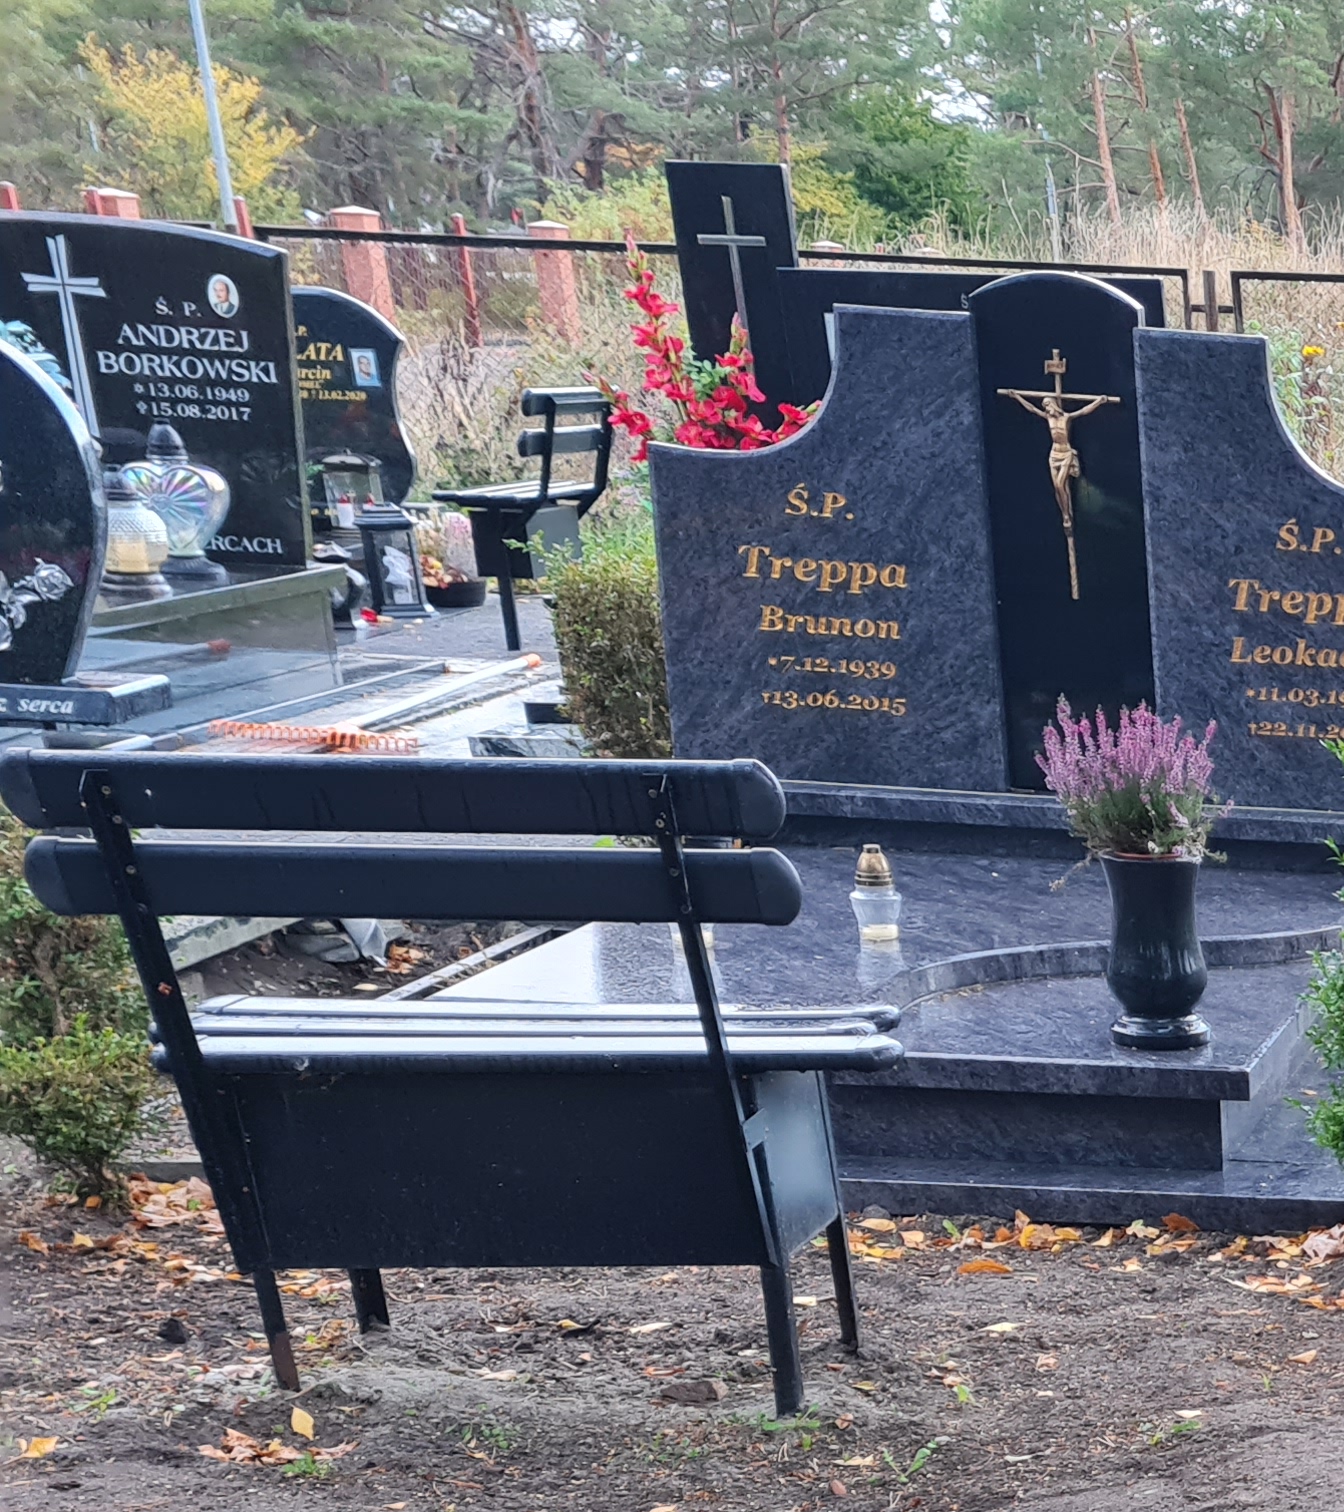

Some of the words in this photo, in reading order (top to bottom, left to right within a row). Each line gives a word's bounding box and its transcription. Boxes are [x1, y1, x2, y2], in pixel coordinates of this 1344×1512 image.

[182, 301, 202, 317] P.
[117, 322, 249, 352] ANDRZEJ
[97, 350, 279, 384] BORKOWSKI
[148, 382, 250, 403] 13.06.1949
[150, 401, 252, 422] 15.08.2017
[785, 483, 855, 520] Ś.P.
[1275, 518, 1342, 555] Ś.P.
[738, 544, 908, 594] Treppa
[758, 604, 901, 640] Brunon
[17, 698, 75, 714] serca
